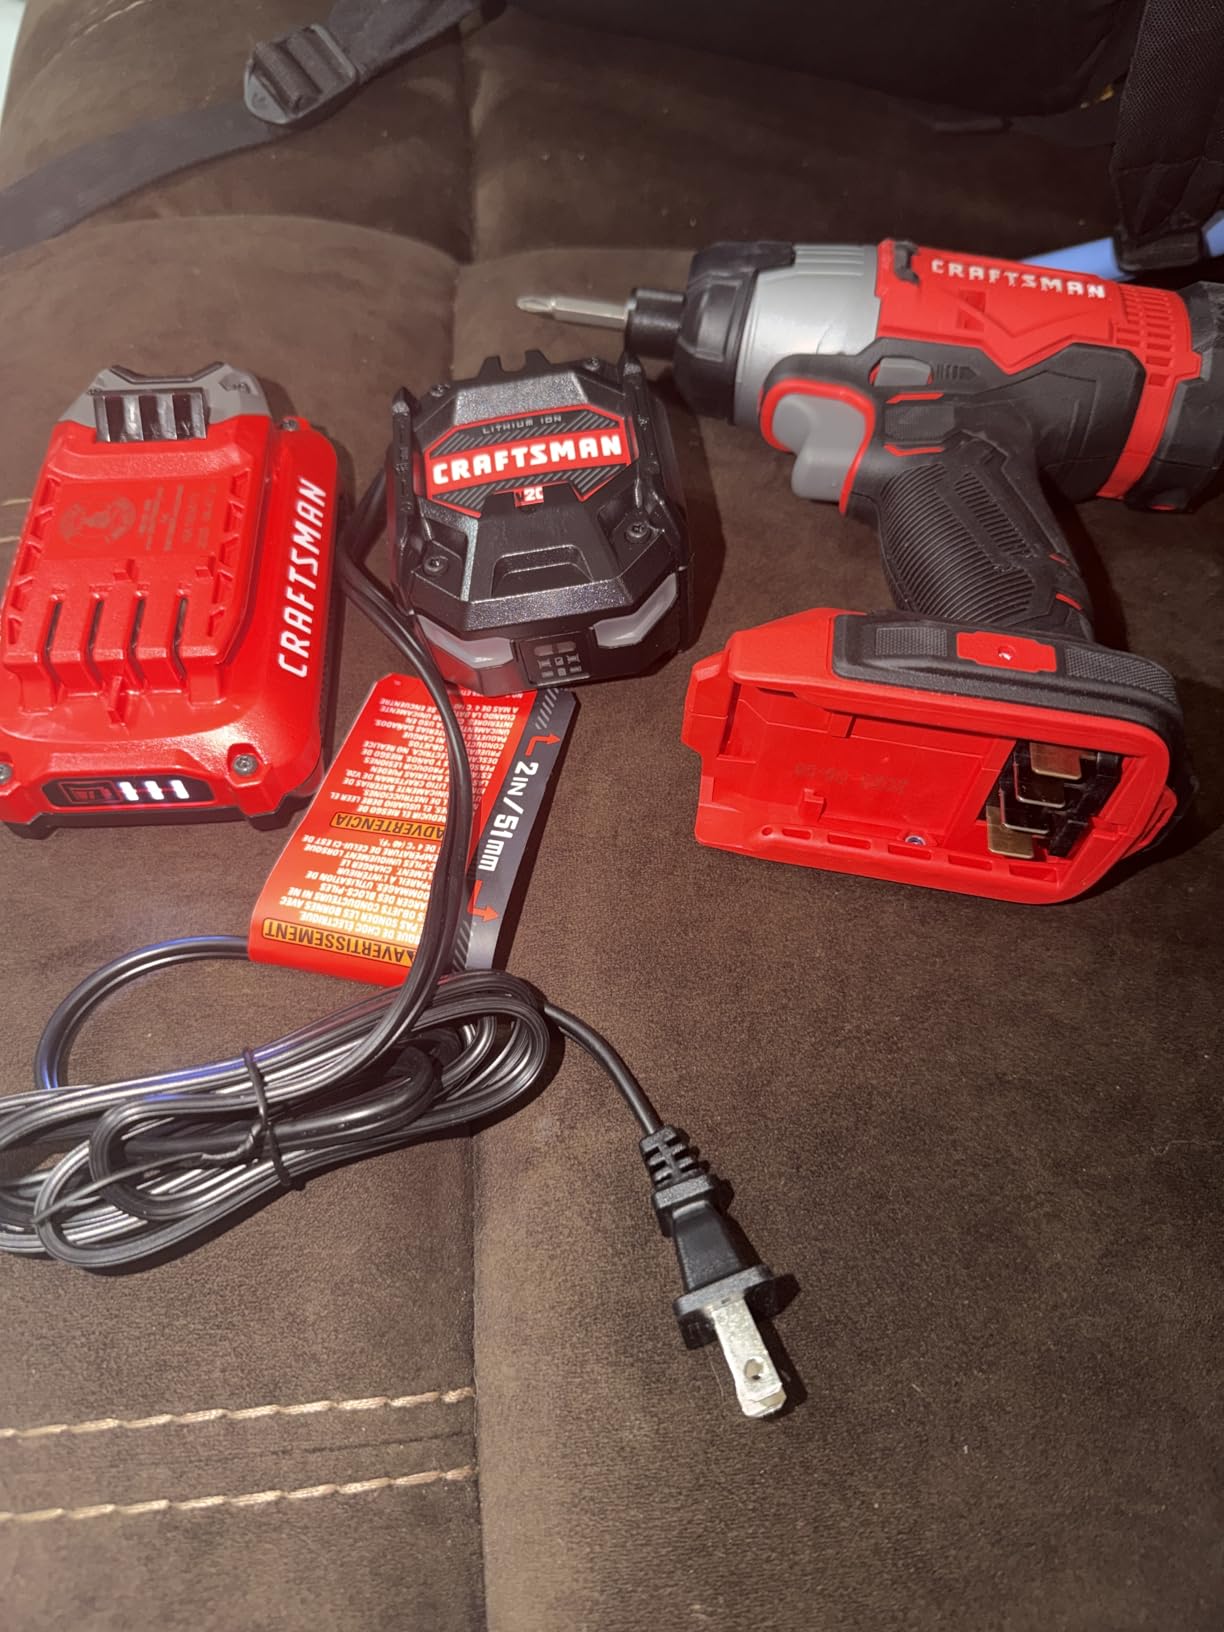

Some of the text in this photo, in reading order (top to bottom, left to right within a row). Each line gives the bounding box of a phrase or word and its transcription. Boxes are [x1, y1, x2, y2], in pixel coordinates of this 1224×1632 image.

[931, 259, 1106, 299] CRAFTSMAN
[482, 415, 562, 435] LITHIUM ION
[433, 434, 622, 485] CRAFTSMAN
[278, 477, 327, 678] CRAFTSMAN
[374, 773, 423, 786] CRAFTSMAN
[356, 804, 369, 813] DE
[335, 814, 445, 838] ADVERTENCIA
[423, 844, 436, 852] DE
[339, 858, 351, 867] LE
[345, 850, 402, 866] UNIQUEMENT
[351, 860, 392, 873] CHARGER
[305, 870, 319, 880] DE
[319, 873, 374, 890] UTILISATION
[319, 882, 376, 901] BLOCS-PILES
[279, 896, 304, 908] AVEC
[287, 886, 416, 920] OBJETS CONDUCTEURS NI NE
[377, 894, 396, 905] DES
[342, 909, 360, 920] LES
[354, 922, 380, 936] CHOC
[382, 928, 395, 939] DE
[265, 921, 405, 962] AVERTISSEMENT
